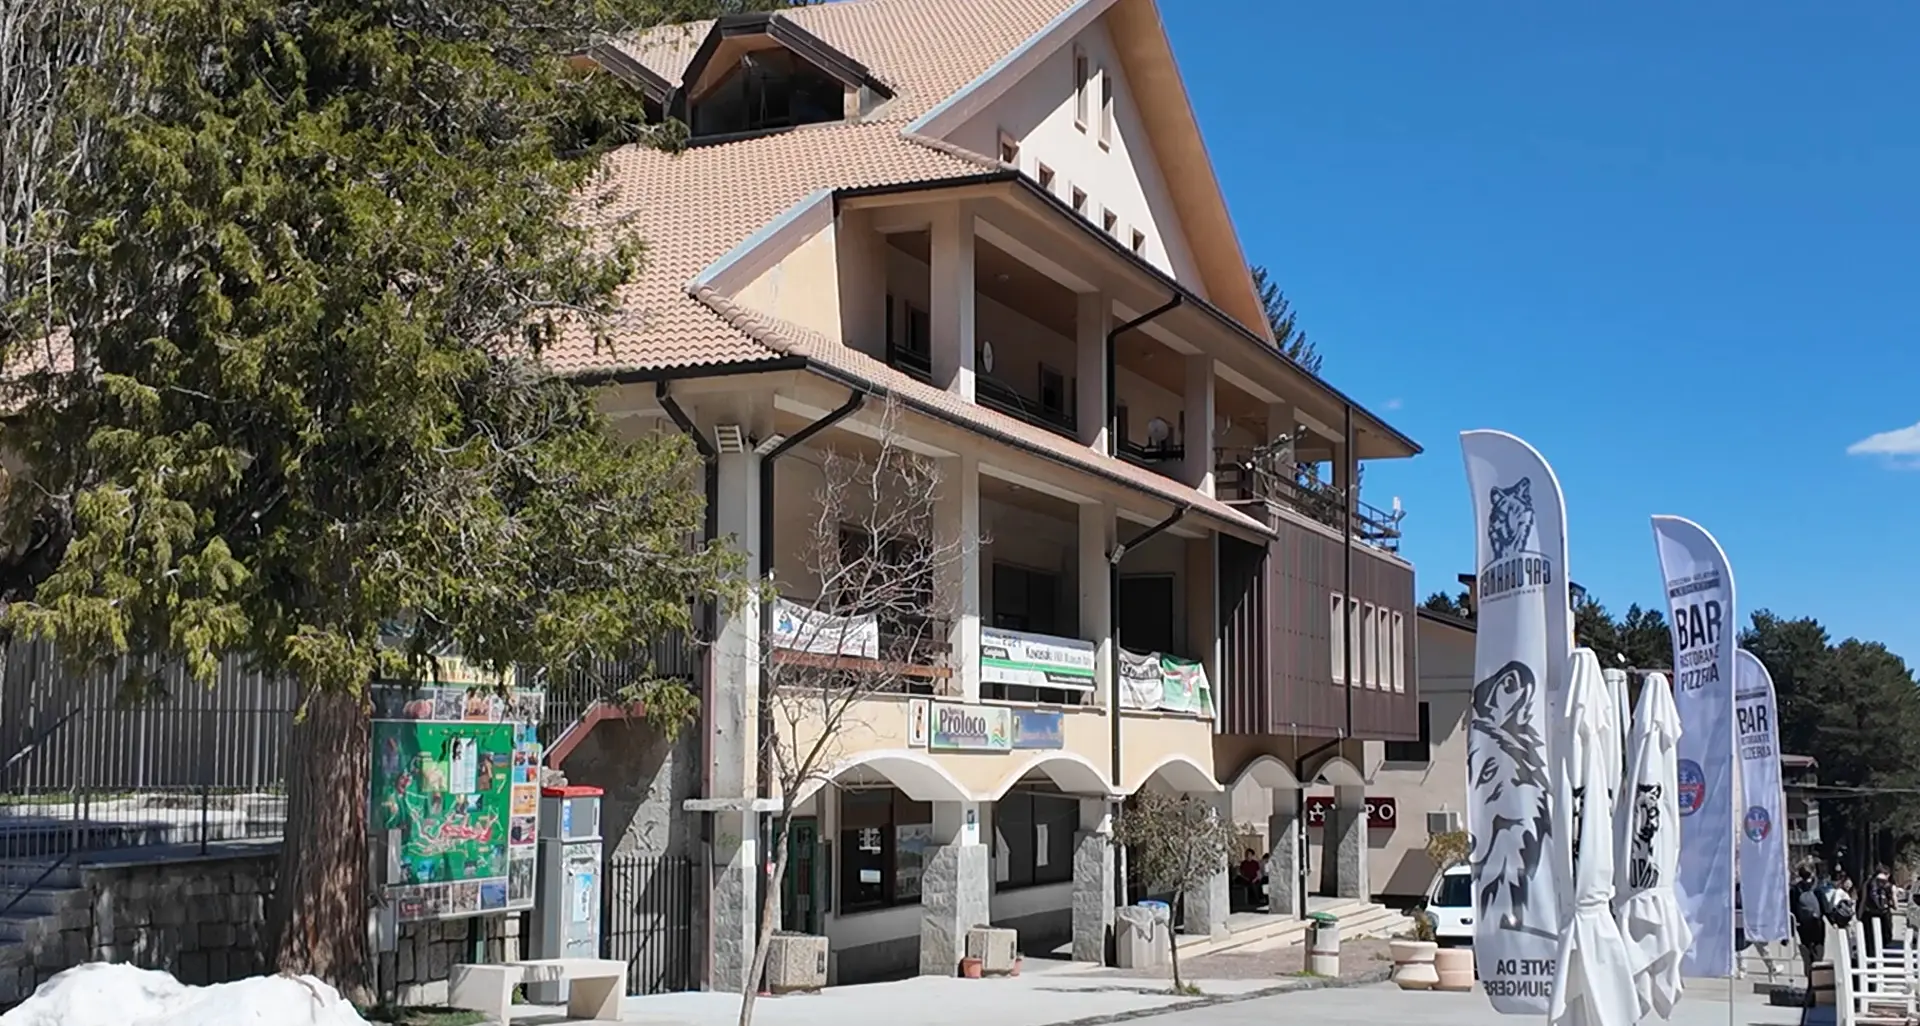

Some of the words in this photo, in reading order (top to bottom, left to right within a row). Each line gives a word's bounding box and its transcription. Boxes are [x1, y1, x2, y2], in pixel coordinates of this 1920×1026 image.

[1675, 600, 1722, 651] BAR
[940, 708, 986, 735] Proloco
[1736, 705, 1769, 735] BAR
